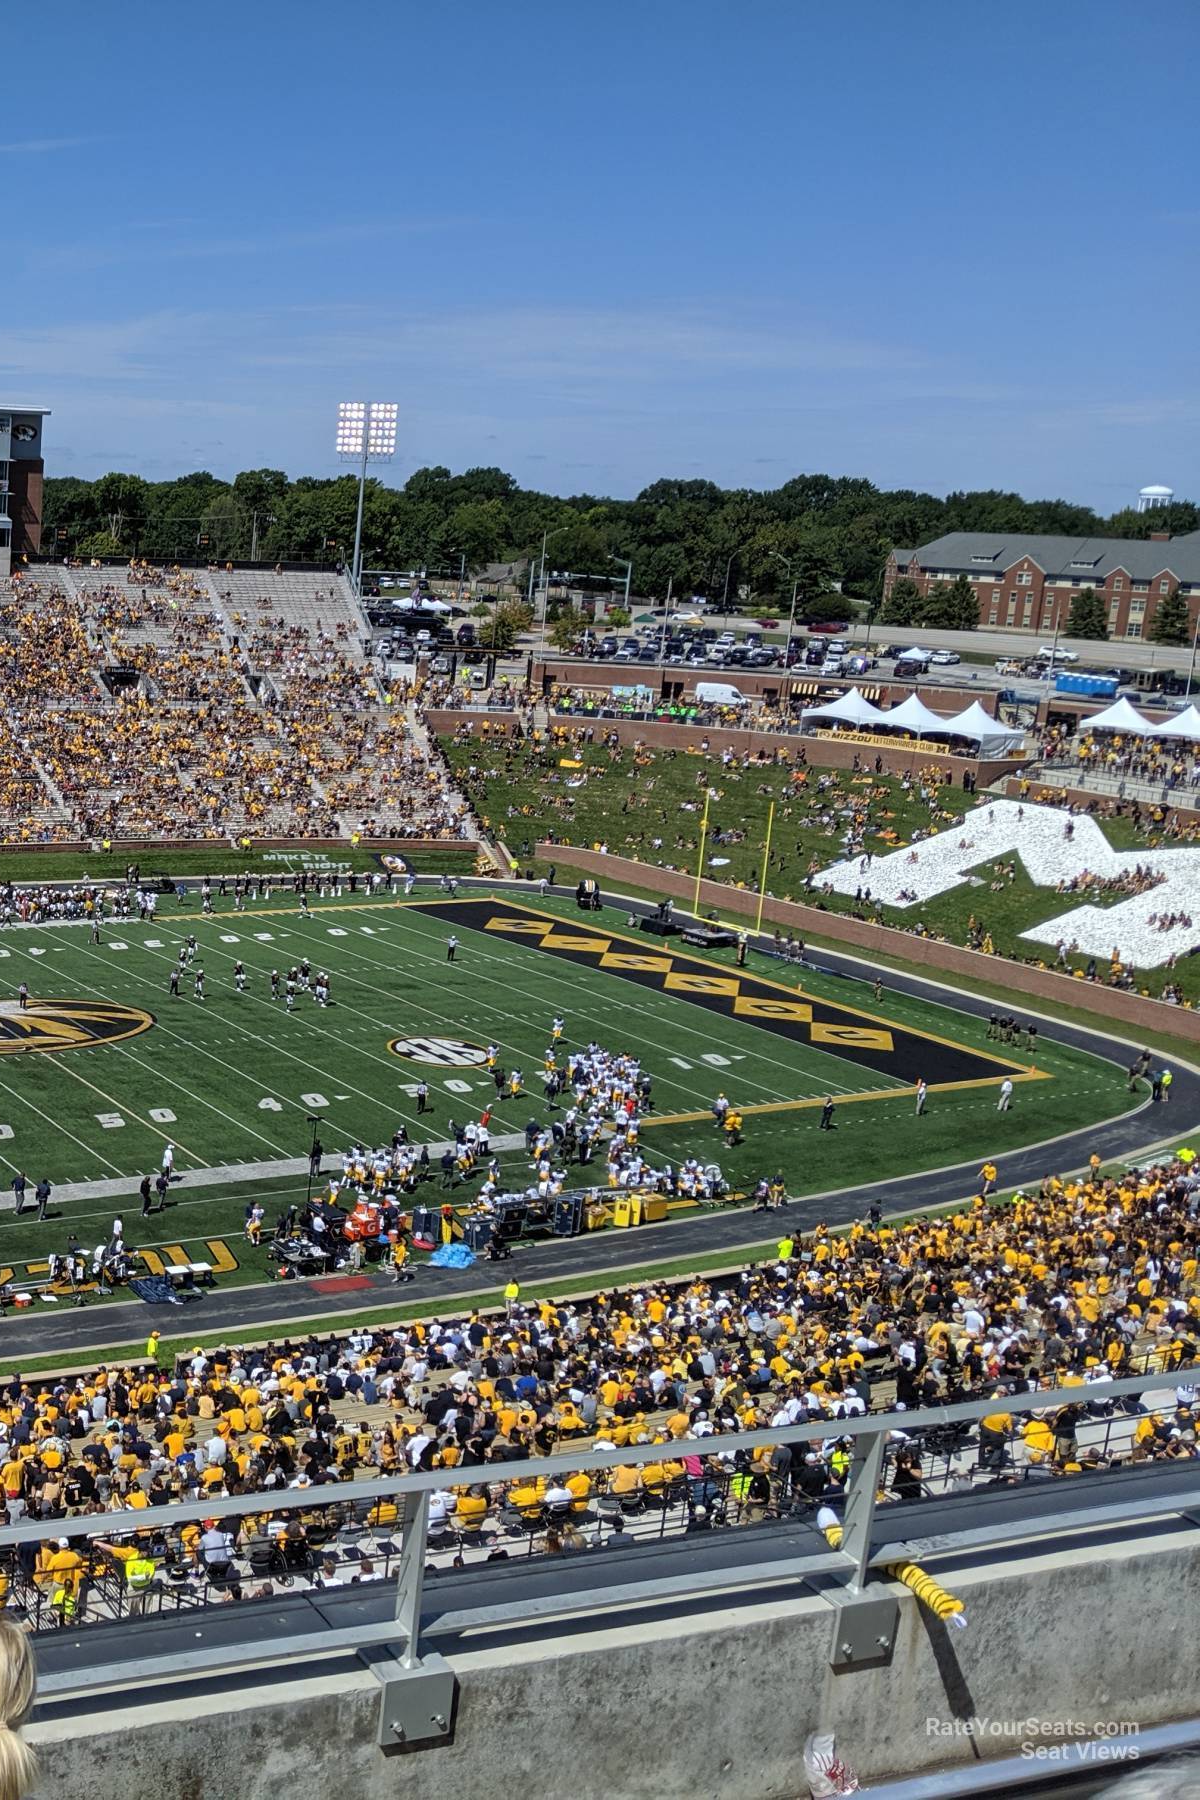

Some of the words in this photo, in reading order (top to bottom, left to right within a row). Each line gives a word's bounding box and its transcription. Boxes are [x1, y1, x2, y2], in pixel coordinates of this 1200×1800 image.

[831, 732, 873, 743] MIZZOU
[919, 743, 934, 751] CLUB
[302, 862, 352, 870] RIGHT
[502, 920, 889, 1043] MIZZOU
[367, 1222, 376, 1233] G
